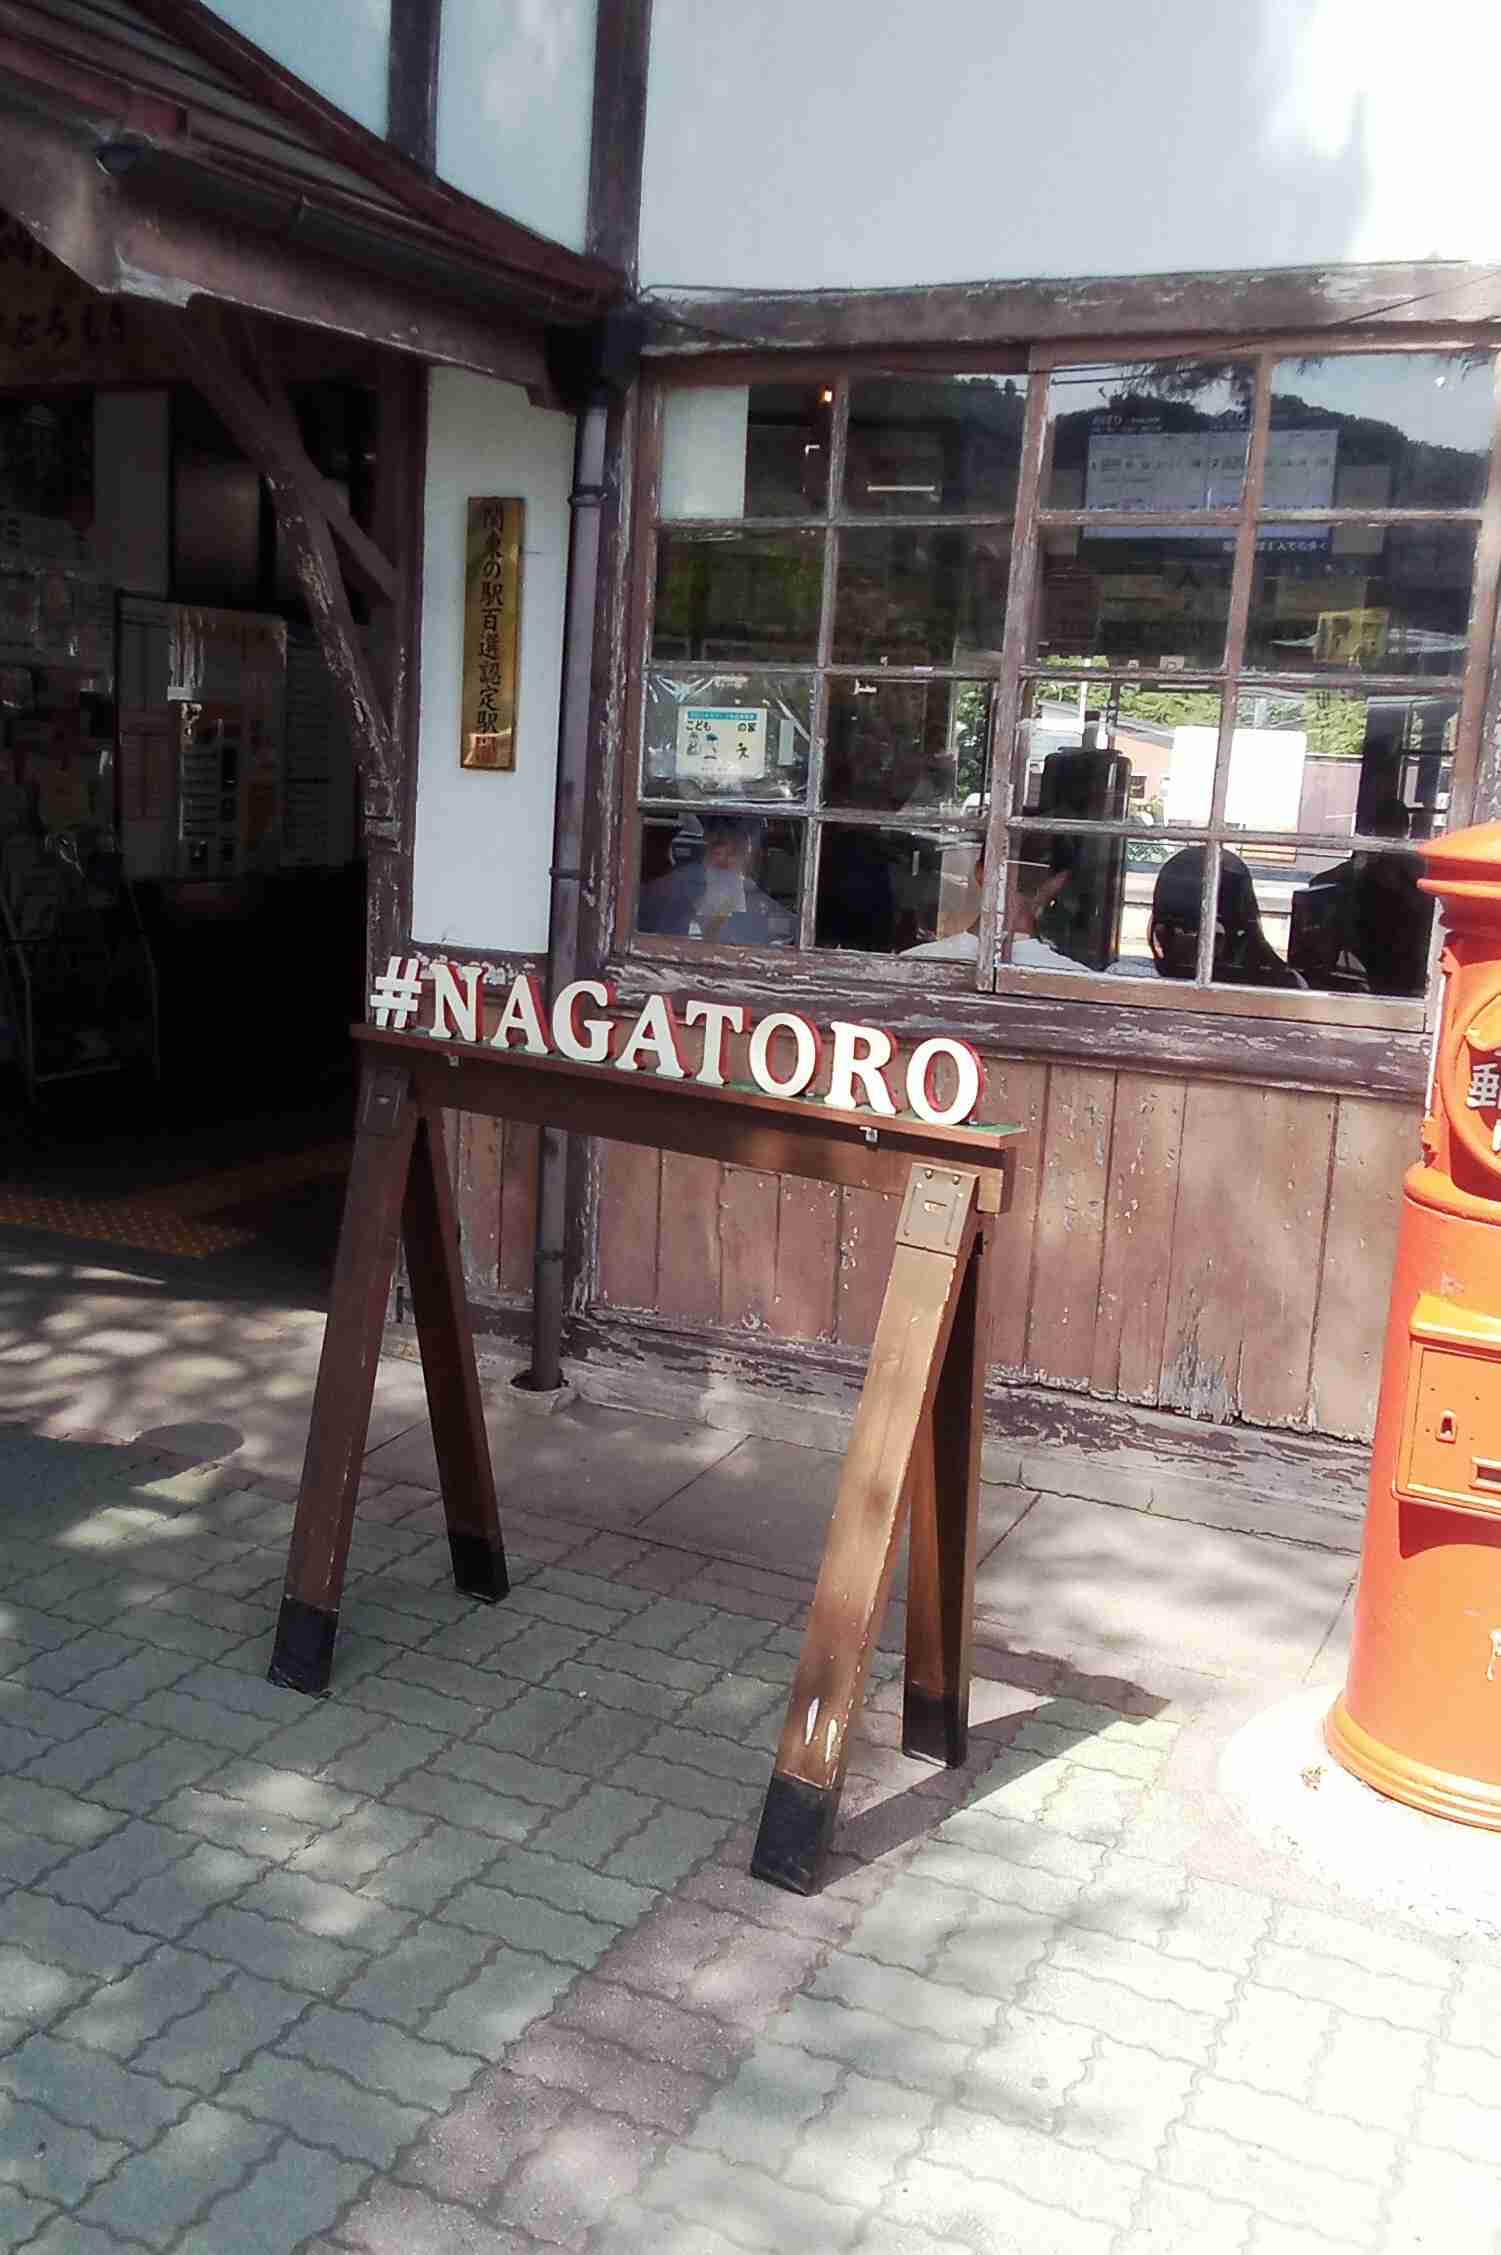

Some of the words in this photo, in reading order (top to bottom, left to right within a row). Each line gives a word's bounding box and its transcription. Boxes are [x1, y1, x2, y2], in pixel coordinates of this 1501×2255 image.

[686, 719, 712, 732] こども
[369, 955, 982, 1126] #NAGATORO
